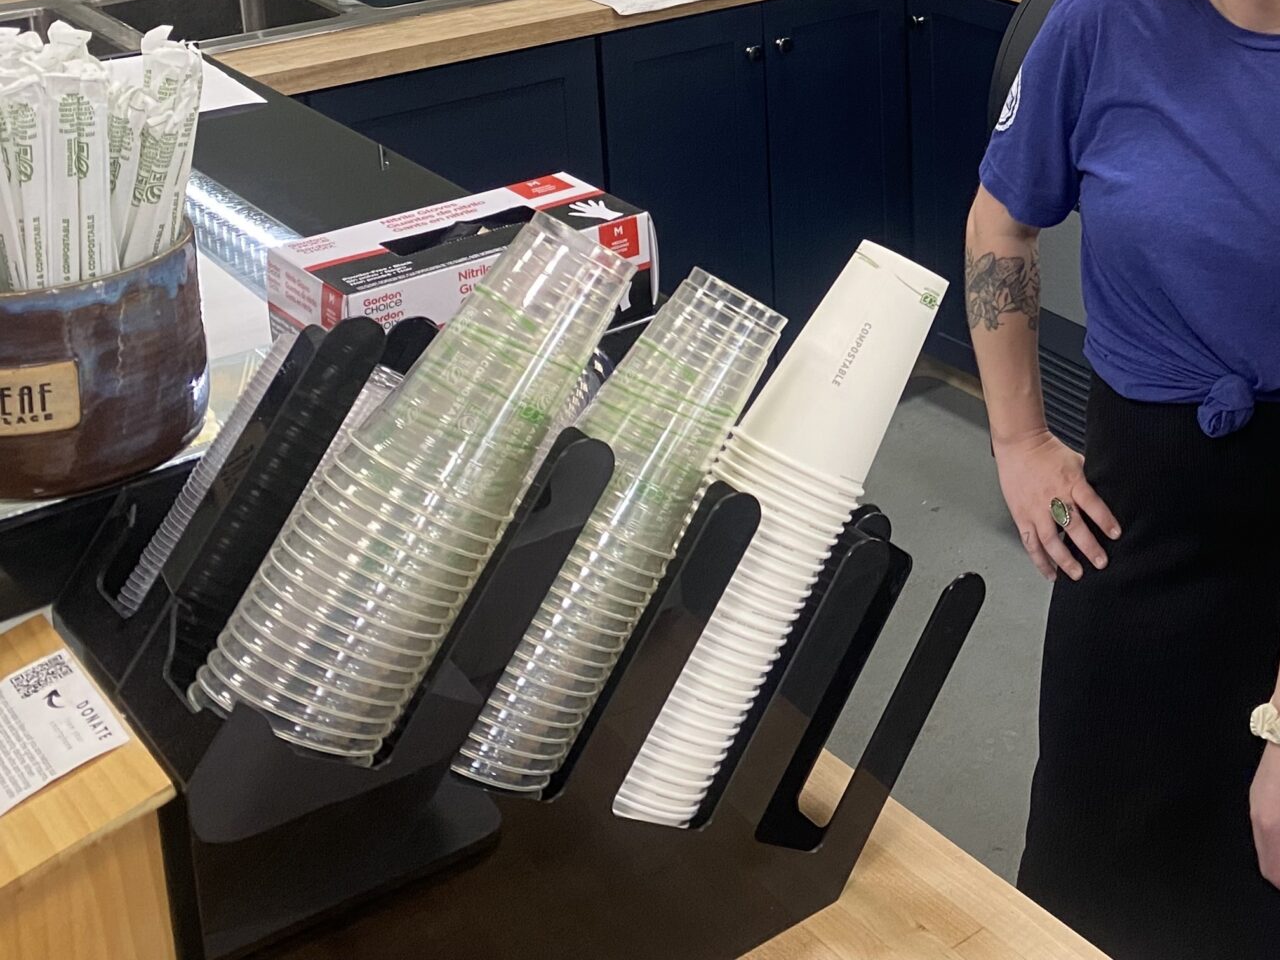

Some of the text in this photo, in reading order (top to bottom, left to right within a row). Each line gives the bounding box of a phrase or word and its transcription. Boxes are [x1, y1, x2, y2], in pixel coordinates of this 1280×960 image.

[380, 203, 457, 225] Nitrile Gloves
[387, 200, 486, 229] Guantes de nitrilo
[393, 208, 478, 233] Gants en nitrile
[33, 216, 43, 273] COMPOSTABLE
[87, 215, 95, 271] COMPOSTABLE
[613, 225, 624, 237] M
[62, 218, 70, 274] COMPOSTABLE
[363, 291, 402, 307] Gordon
[364, 299, 403, 316] CHOICE
[832, 322, 872, 388] COMPOSTABLE
[76, 700, 113, 741] DONATE
